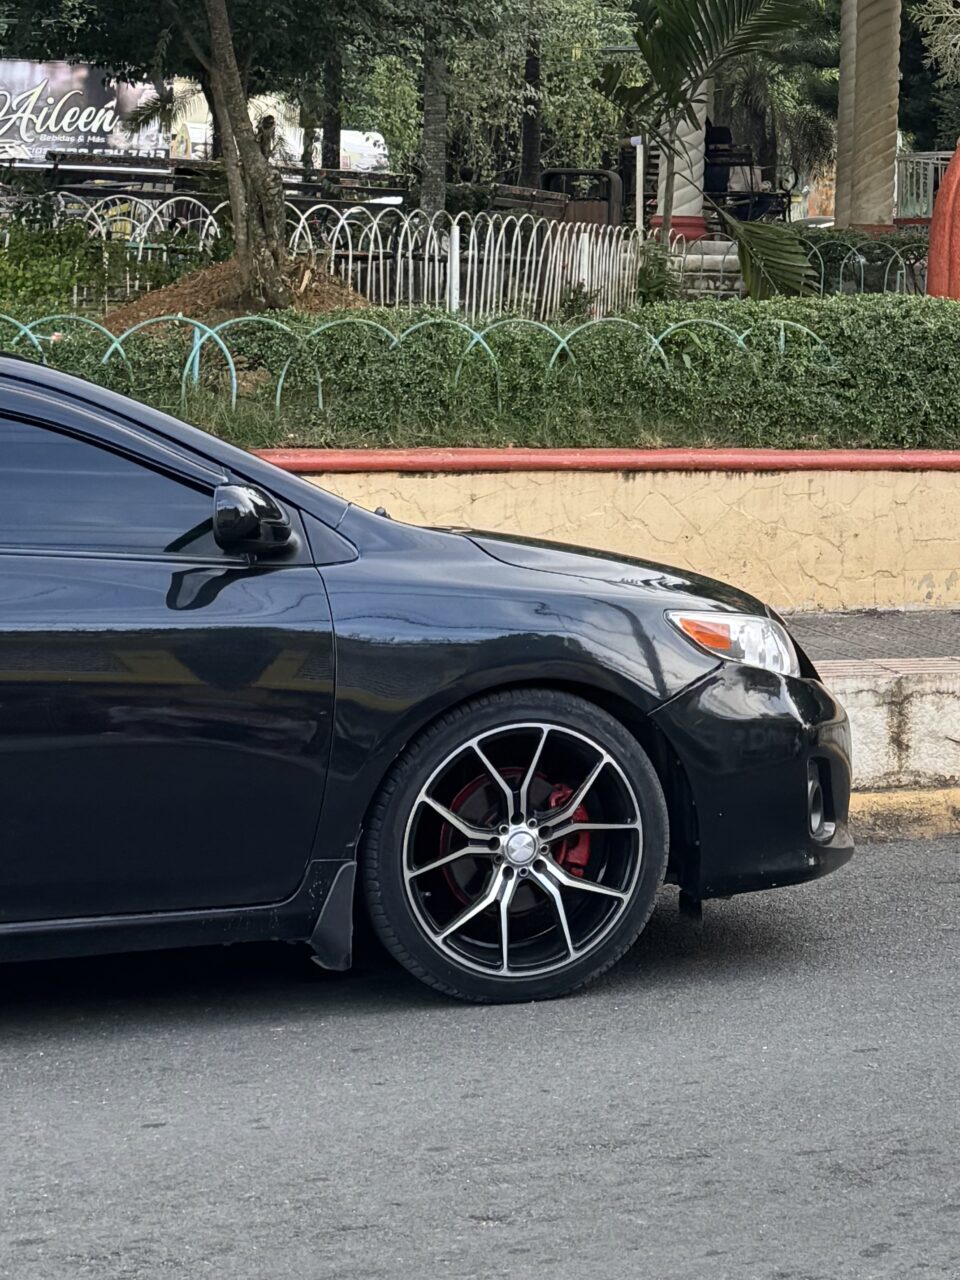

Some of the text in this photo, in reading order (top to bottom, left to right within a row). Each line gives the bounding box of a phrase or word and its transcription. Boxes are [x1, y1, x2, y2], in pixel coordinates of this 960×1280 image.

[0, 79, 119, 142] Aileen
[40, 134, 75, 142] Bebidas
[77, 135, 85, 143] &
